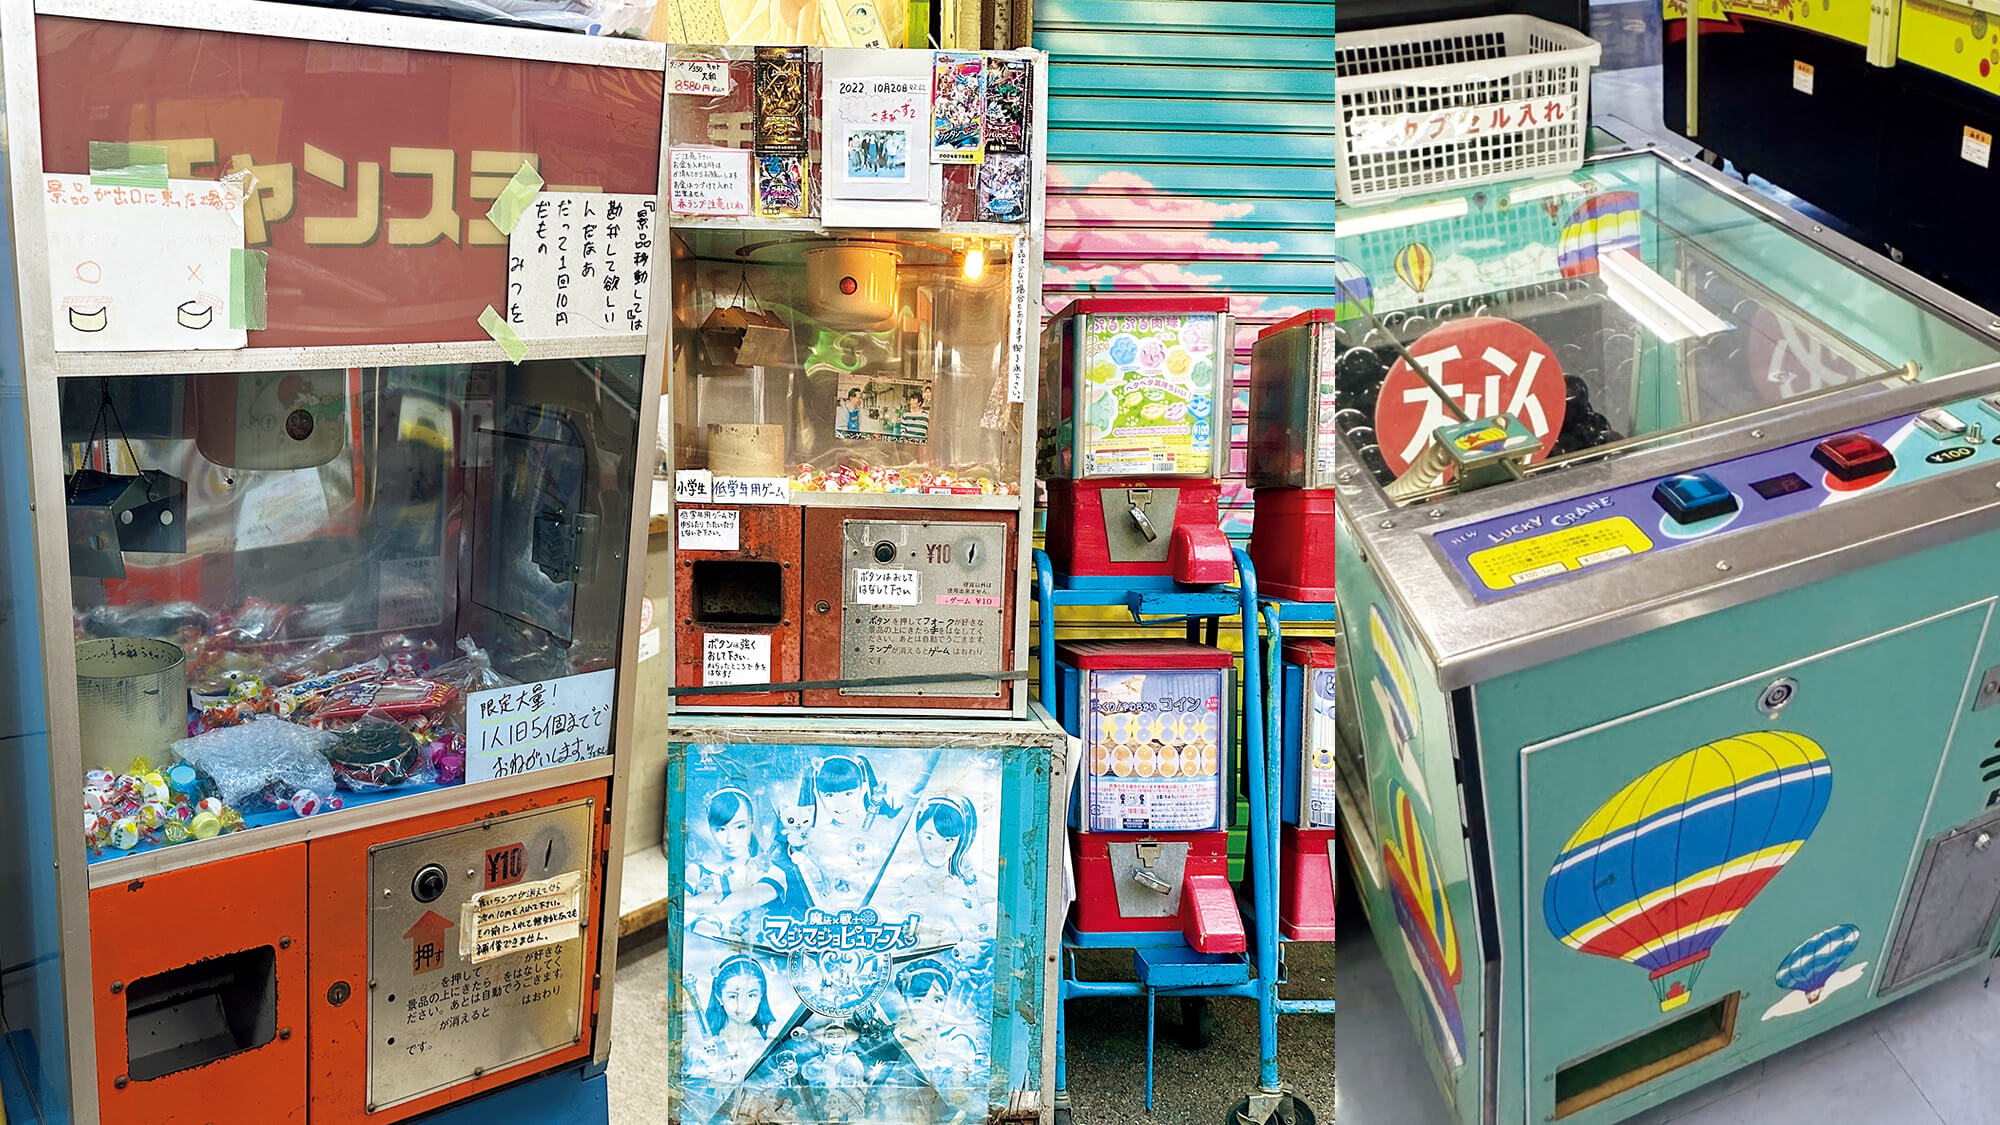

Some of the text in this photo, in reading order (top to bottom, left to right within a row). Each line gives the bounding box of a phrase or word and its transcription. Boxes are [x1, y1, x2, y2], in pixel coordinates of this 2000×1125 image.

[536, 201, 551, 255] だもの
[510, 257, 525, 323] みつを
[1400, 345, 1550, 488] 秘
[1931, 446, 1971, 463] ¥100
[677, 478, 707, 496] 小学生
[714, 480, 785, 499] 低学年用ゲーム
[1487, 514, 1544, 544] LUCKY
[1550, 496, 1616, 528] CRANE
[926, 543, 951, 564] ¥10
[860, 571, 913, 582] ボタンはおして
[859, 584, 912, 595] はなして下さい
[1159, 697, 1201, 712] コイン
[488, 847, 523, 883] ¥10
[415, 942, 444, 971] 押す
